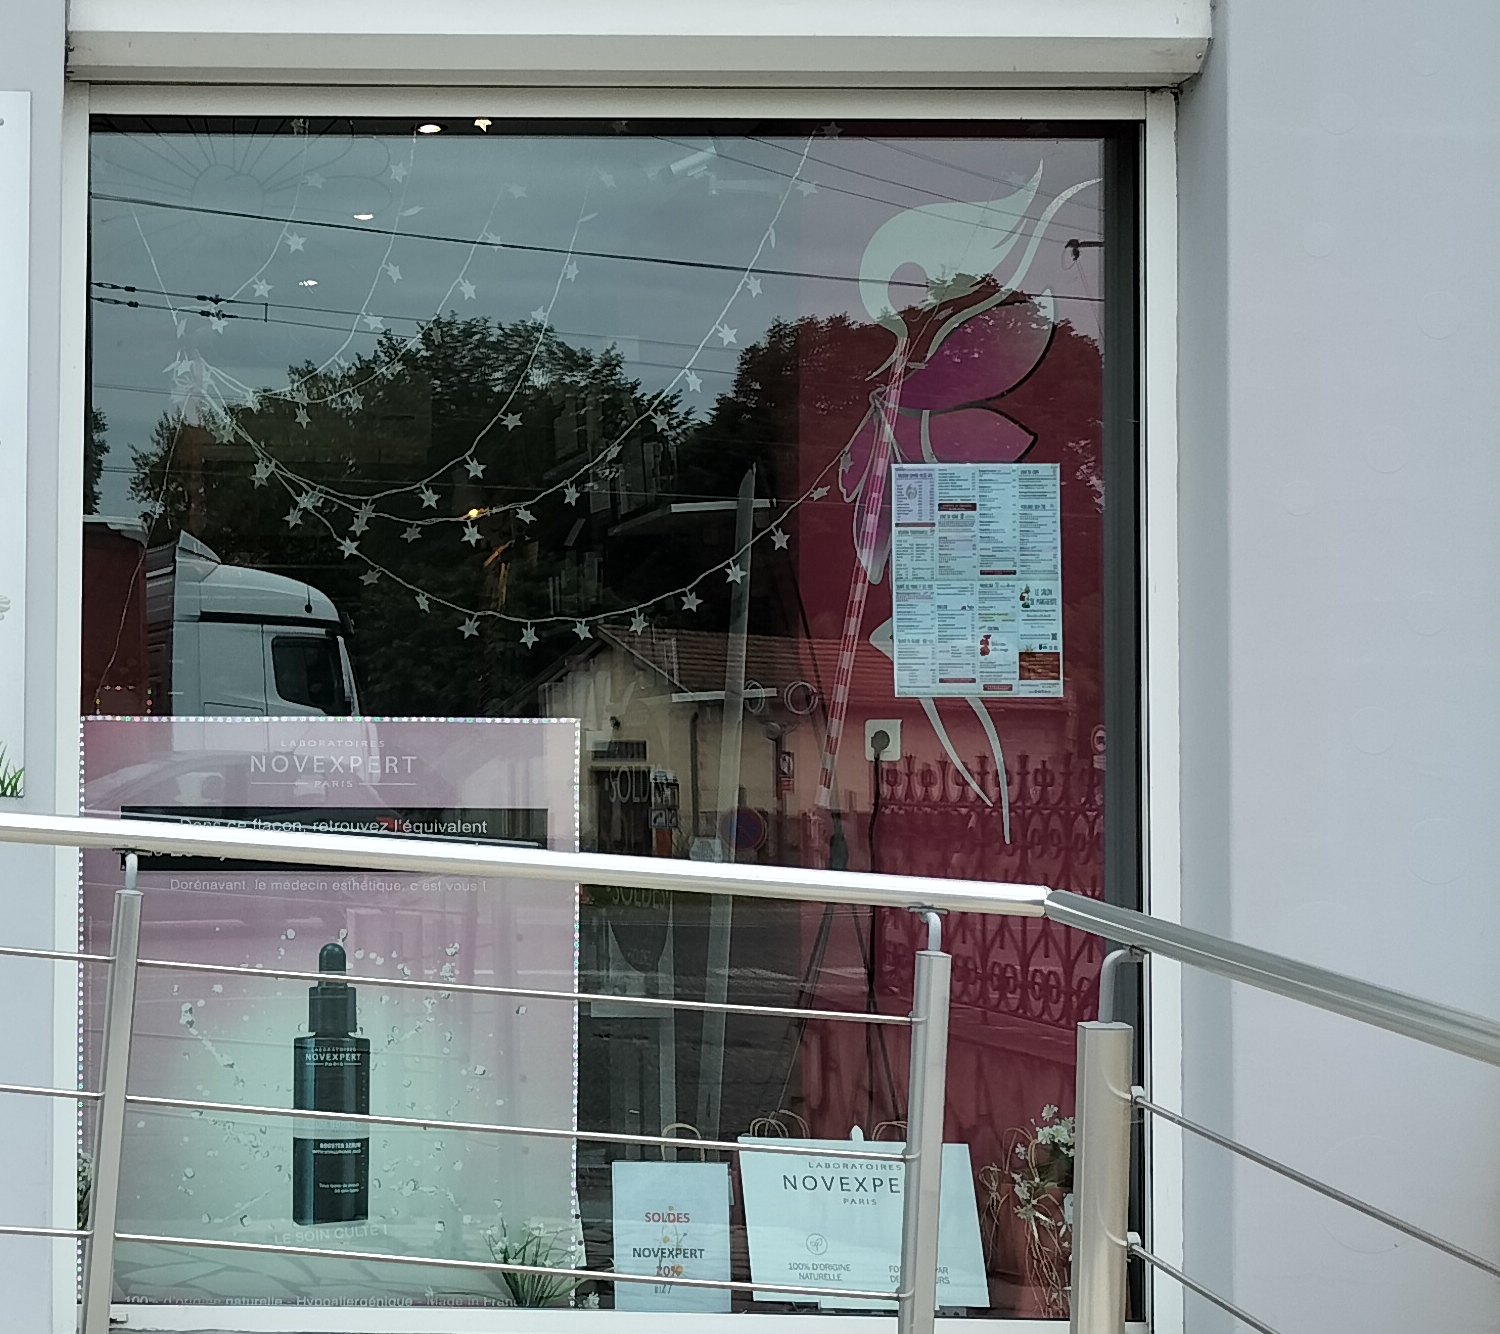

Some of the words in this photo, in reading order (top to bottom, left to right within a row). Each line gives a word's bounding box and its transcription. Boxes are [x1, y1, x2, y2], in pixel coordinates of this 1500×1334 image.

[280, 739, 385, 748] LABORATOIRES
[251, 755, 417, 773] NOVEXPERT
[314, 780, 353, 788] PARIS
[312, 819, 388, 833] retrouvez
[394, 818, 488, 835] l'équivalent
[170, 878, 249, 892] Dorénavant,
[255, 878, 267, 891] le
[270, 878, 328, 891] médecin
[445, 882, 477, 891] vous
[305, 1053, 362, 1062] NOVEXPERT
[808, 1161, 902, 1171] LABORATOIRES
[782, 1174, 901, 1194] NOVEXPE
[843, 1197, 878, 1206] PARIS
[644, 1212, 691, 1224] SOLDES
[274, 1232, 291, 1244] LE
[295, 1228, 330, 1243] SOIN
[334, 1224, 378, 1239] CULTE
[632, 1247, 705, 1260] NOVEXPERT
[788, 1262, 810, 1271] 100%
[811, 1262, 851, 1272] D'ORIGINE
[798, 1273, 842, 1282] NATURELLE
